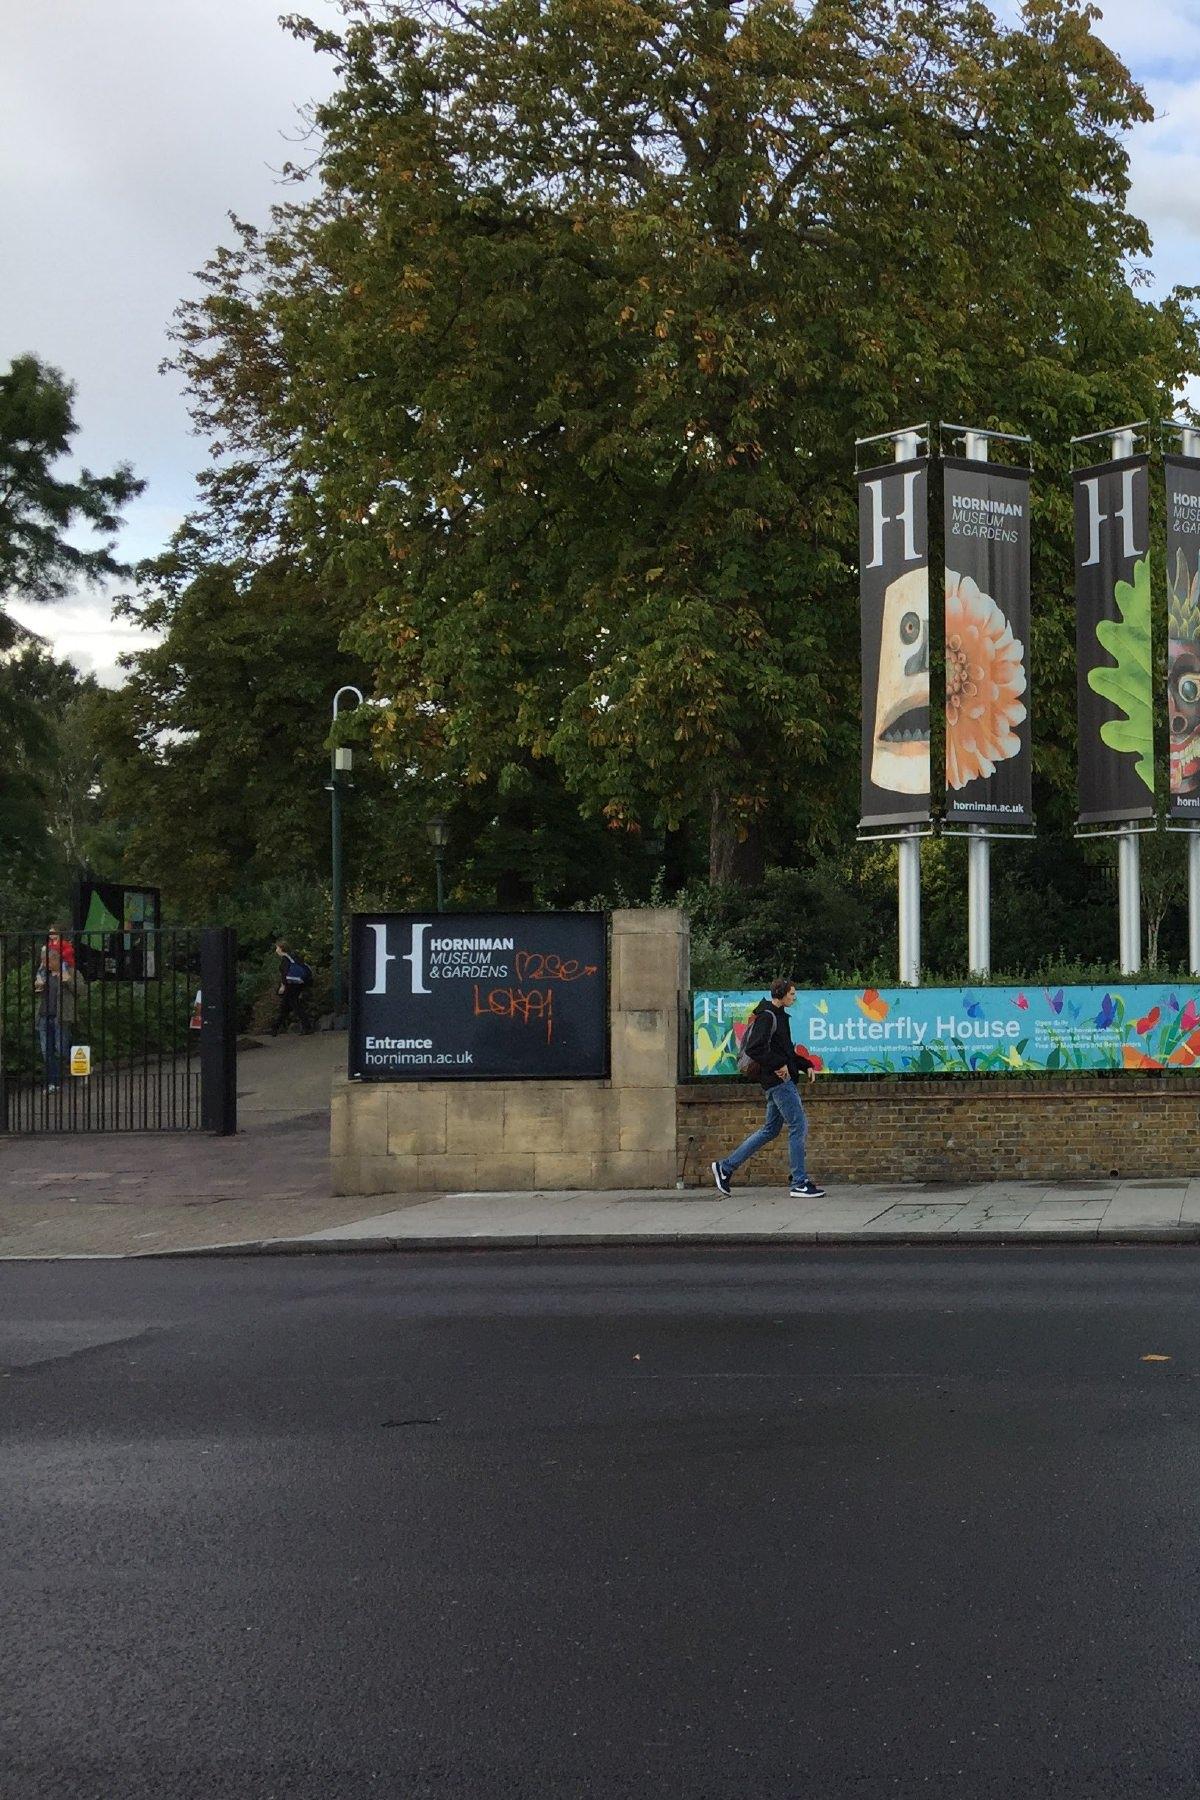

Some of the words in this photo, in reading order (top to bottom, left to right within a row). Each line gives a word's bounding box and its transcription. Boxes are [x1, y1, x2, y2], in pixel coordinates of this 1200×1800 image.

[952, 496, 1022, 517] HORNIMAN
[864, 470, 922, 568] H
[952, 509, 1004, 527] MUSEUM
[1079, 467, 1143, 567] H
[952, 522, 960, 535] &
[962, 524, 1018, 543] GARDENS
[1173, 520, 1181, 533] &
[953, 800, 1024, 813] horniman.ac.uk
[430, 938, 514, 951] HORNIMAN
[365, 923, 432, 994] H
[429, 952, 491, 965] MUSEUM
[429, 966, 440, 979] &
[441, 965, 508, 979] GARDENS
[809, 1017, 928, 1045] Butterfly
[936, 1016, 1021, 1038] House
[365, 1036, 433, 1050] Entrance
[365, 1051, 474, 1065] horniman.ac.uk
